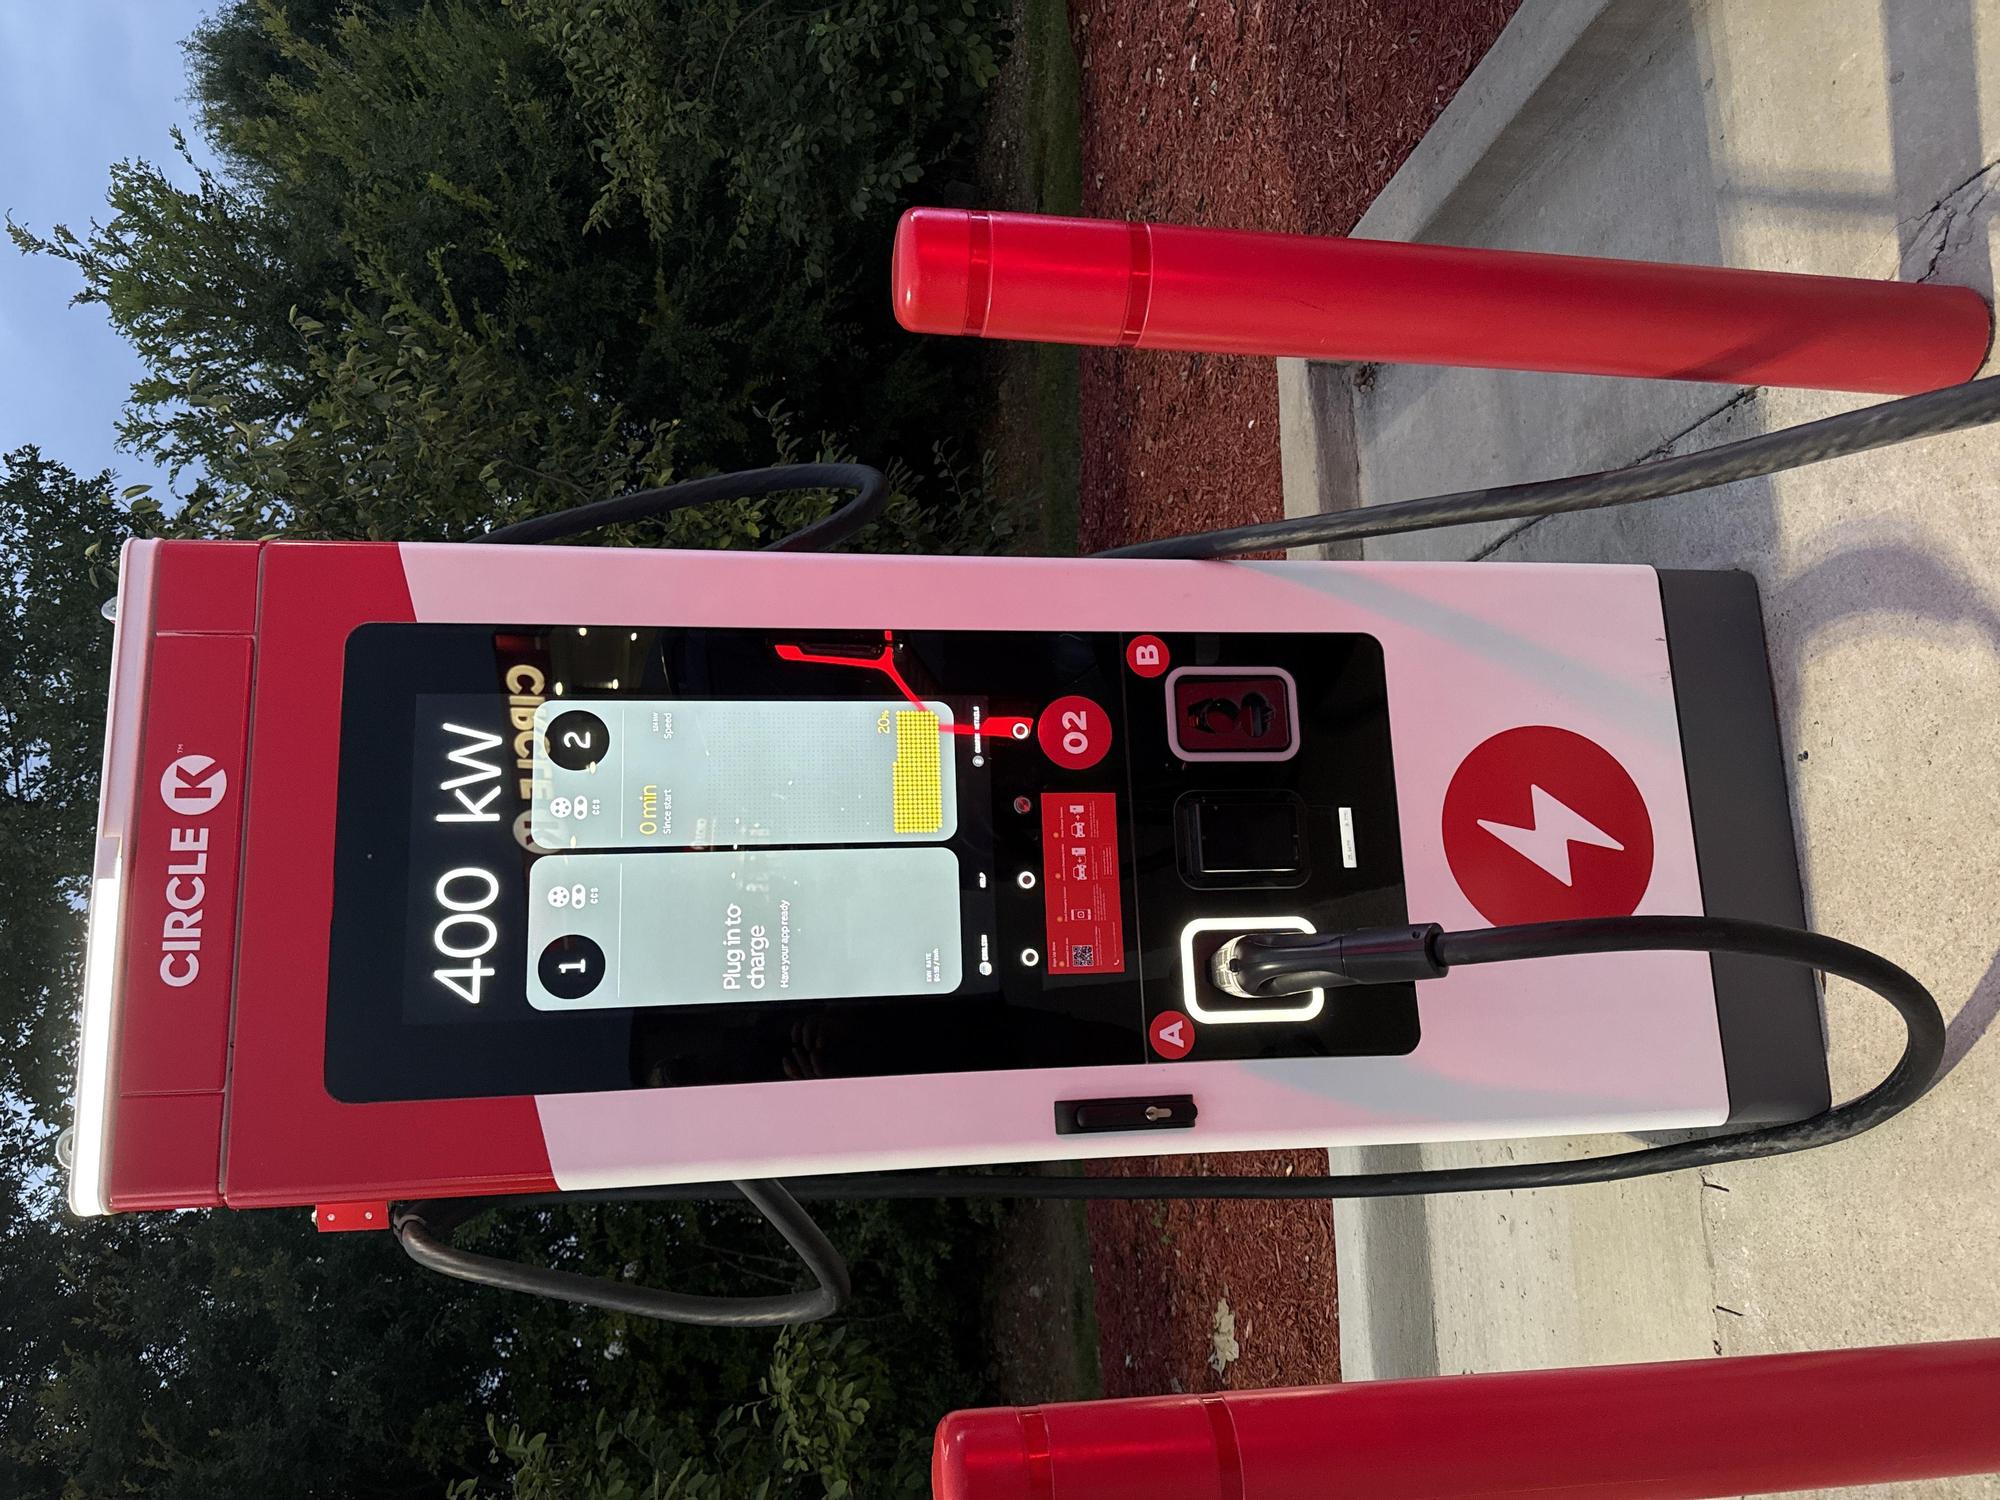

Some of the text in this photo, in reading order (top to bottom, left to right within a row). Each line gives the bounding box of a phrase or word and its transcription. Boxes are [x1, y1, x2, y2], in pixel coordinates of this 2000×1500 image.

[1136, 644, 1159, 666] B
[563, 731, 591, 749] 2
[664, 713, 674, 739] Speed
[1062, 711, 1089, 755] 02
[170, 757, 226, 803] K
[592, 799, 600, 815] CCS
[639, 785, 657, 835] 0 min
[663, 789, 672, 834] Since start
[434, 723, 502, 1004] 400 kW
[159, 828, 209, 987] CIRCLE
[590, 888, 599, 904] CCS
[558, 959, 586, 973] 1
[722, 904, 745, 990] Plug in to
[746, 925, 769, 989] charge
[780, 900, 790, 988] Have your app ready
[1159, 1021, 1185, 1048] A
